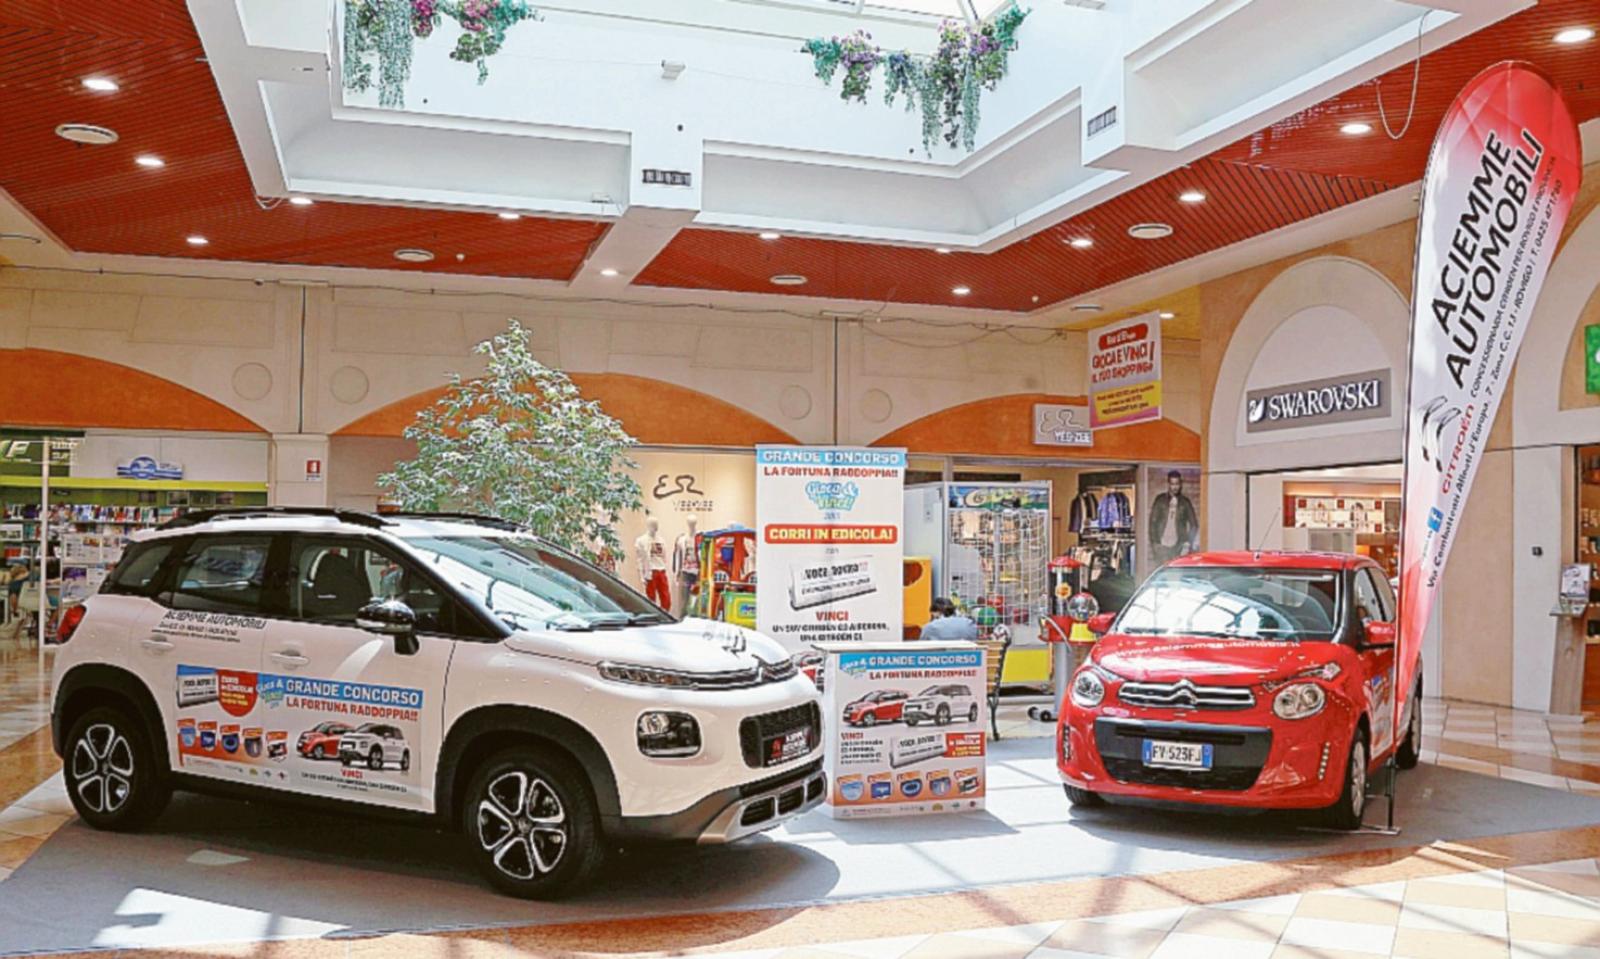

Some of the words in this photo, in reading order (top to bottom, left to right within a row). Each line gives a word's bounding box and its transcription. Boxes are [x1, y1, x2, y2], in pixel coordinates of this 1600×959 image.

[1431, 133, 1511, 335] ACIEMME
[1446, 130, 1543, 390] AUTOMOBILI
[1268, 379, 1379, 420] SWAROVSKI
[1427, 569, 1438, 588] Via
[1515, 265, 1533, 308] ROVIGO
[763, 451, 820, 462] GRANDE
[825, 452, 899, 463] CONCORSO
[764, 467, 780, 476] LA
[781, 467, 831, 477] FORTUNA
[769, 528, 811, 540] CORRI
[814, 529, 828, 540] IN
[831, 529, 893, 540] EDICOLA!
[163, 611, 207, 622] ACIEMME
[207, 615, 267, 629] AUTOMOBILI
[816, 611, 849, 621] VINCI
[869, 655, 916, 666] GRANDE
[918, 654, 976, 665] CONCORSO
[286, 679, 340, 697] GRANDE
[343, 685, 420, 706] CONCORSO
[286, 696, 300, 708] LA
[301, 698, 348, 714] FORTUNA
